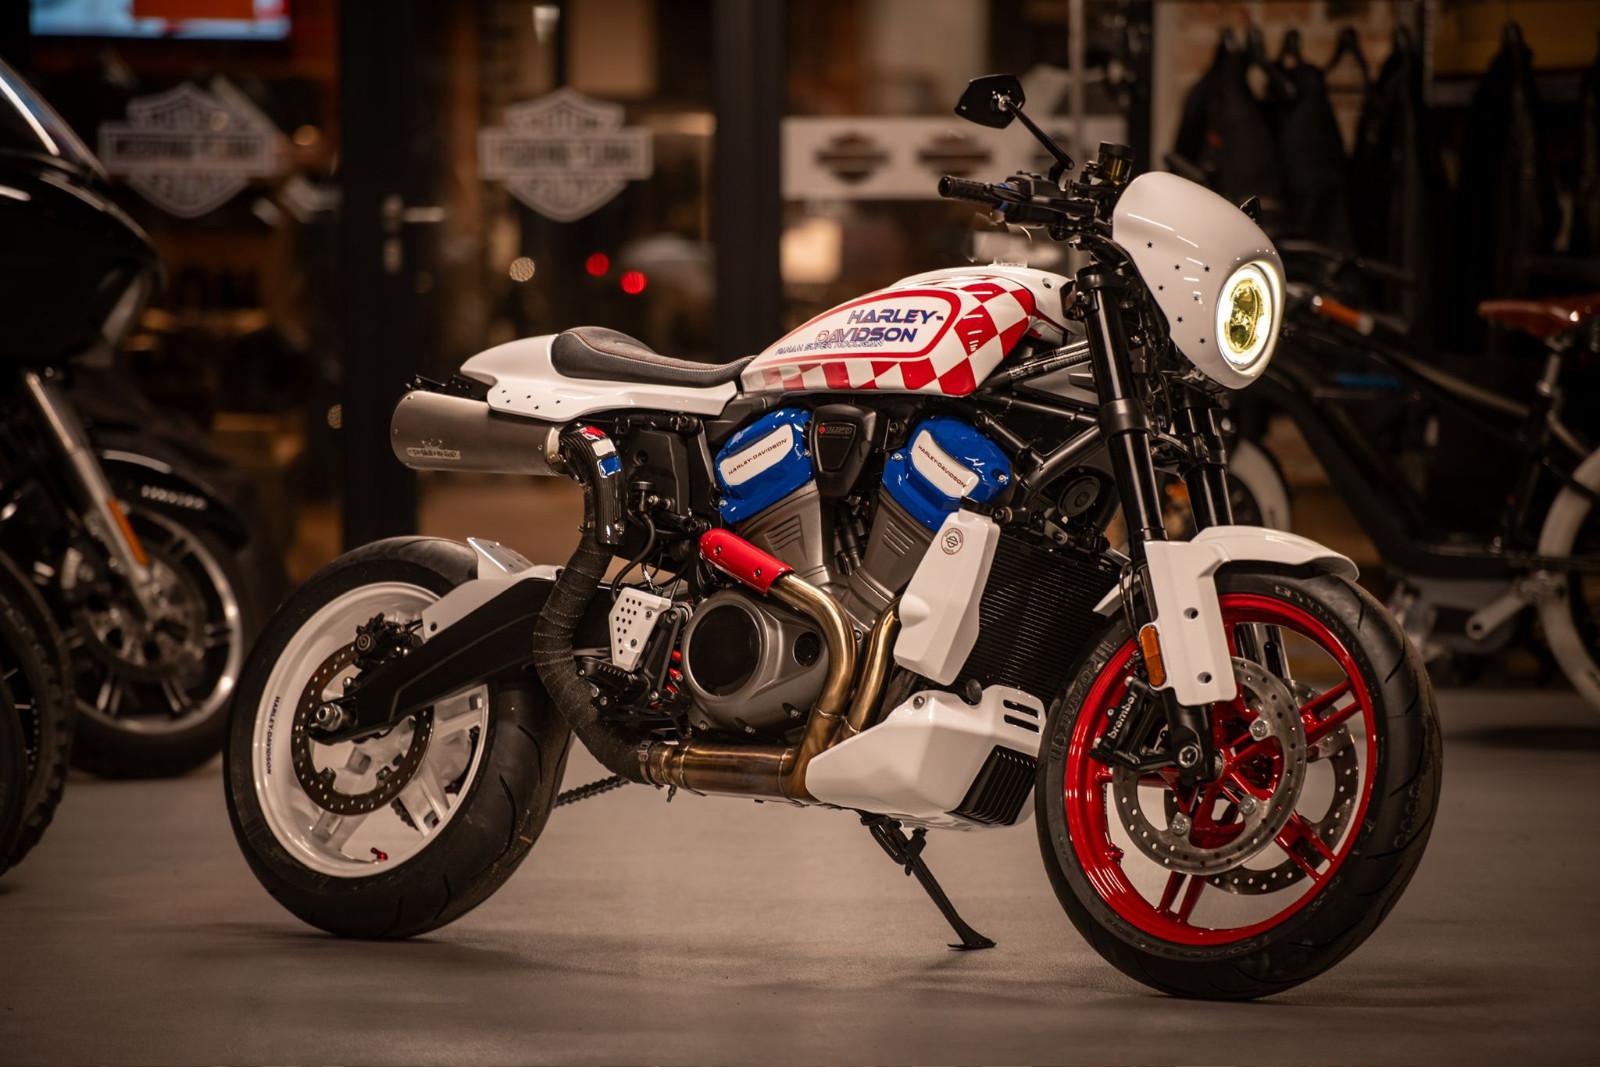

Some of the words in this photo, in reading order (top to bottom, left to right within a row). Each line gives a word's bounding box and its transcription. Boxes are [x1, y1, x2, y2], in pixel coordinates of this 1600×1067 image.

[815, 327, 918, 342] DAVIDSON
[846, 308, 944, 324] HARLEY-
[728, 438, 787, 475] HARLEY-DAVIDSON
[918, 444, 967, 488] HARLEY-DAVIDSON
[266, 695, 281, 775] HARLEY-DAVIDSON
[1107, 695, 1136, 739] brembo
